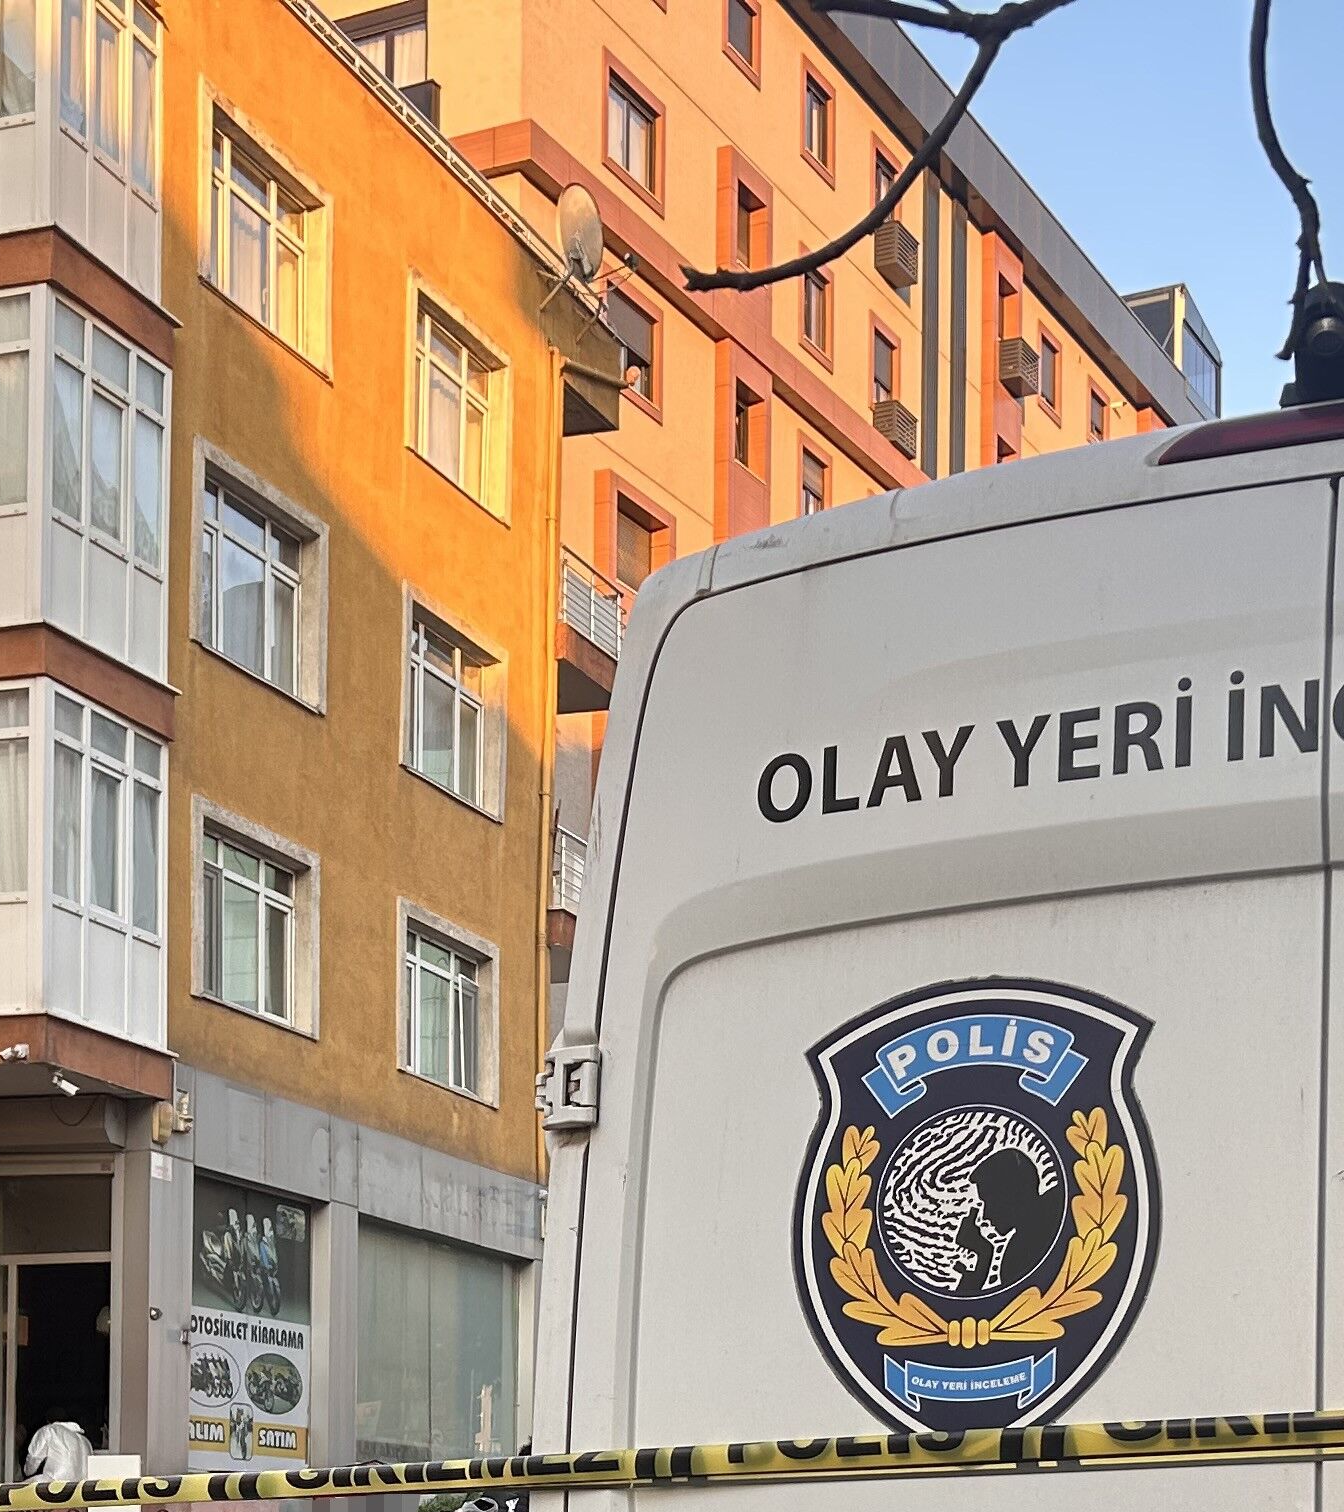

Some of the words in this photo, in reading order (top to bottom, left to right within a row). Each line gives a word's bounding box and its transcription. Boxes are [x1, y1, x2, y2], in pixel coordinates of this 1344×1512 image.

[757, 723, 975, 823] OLAY
[996, 676, 1195, 787] YERİ
[886, 1019, 1055, 1080] POLİS
[911, 1375, 940, 1389] OLAY
[942, 1380, 968, 1391] YERİ
[970, 1371, 1027, 1391] İNCELEME
